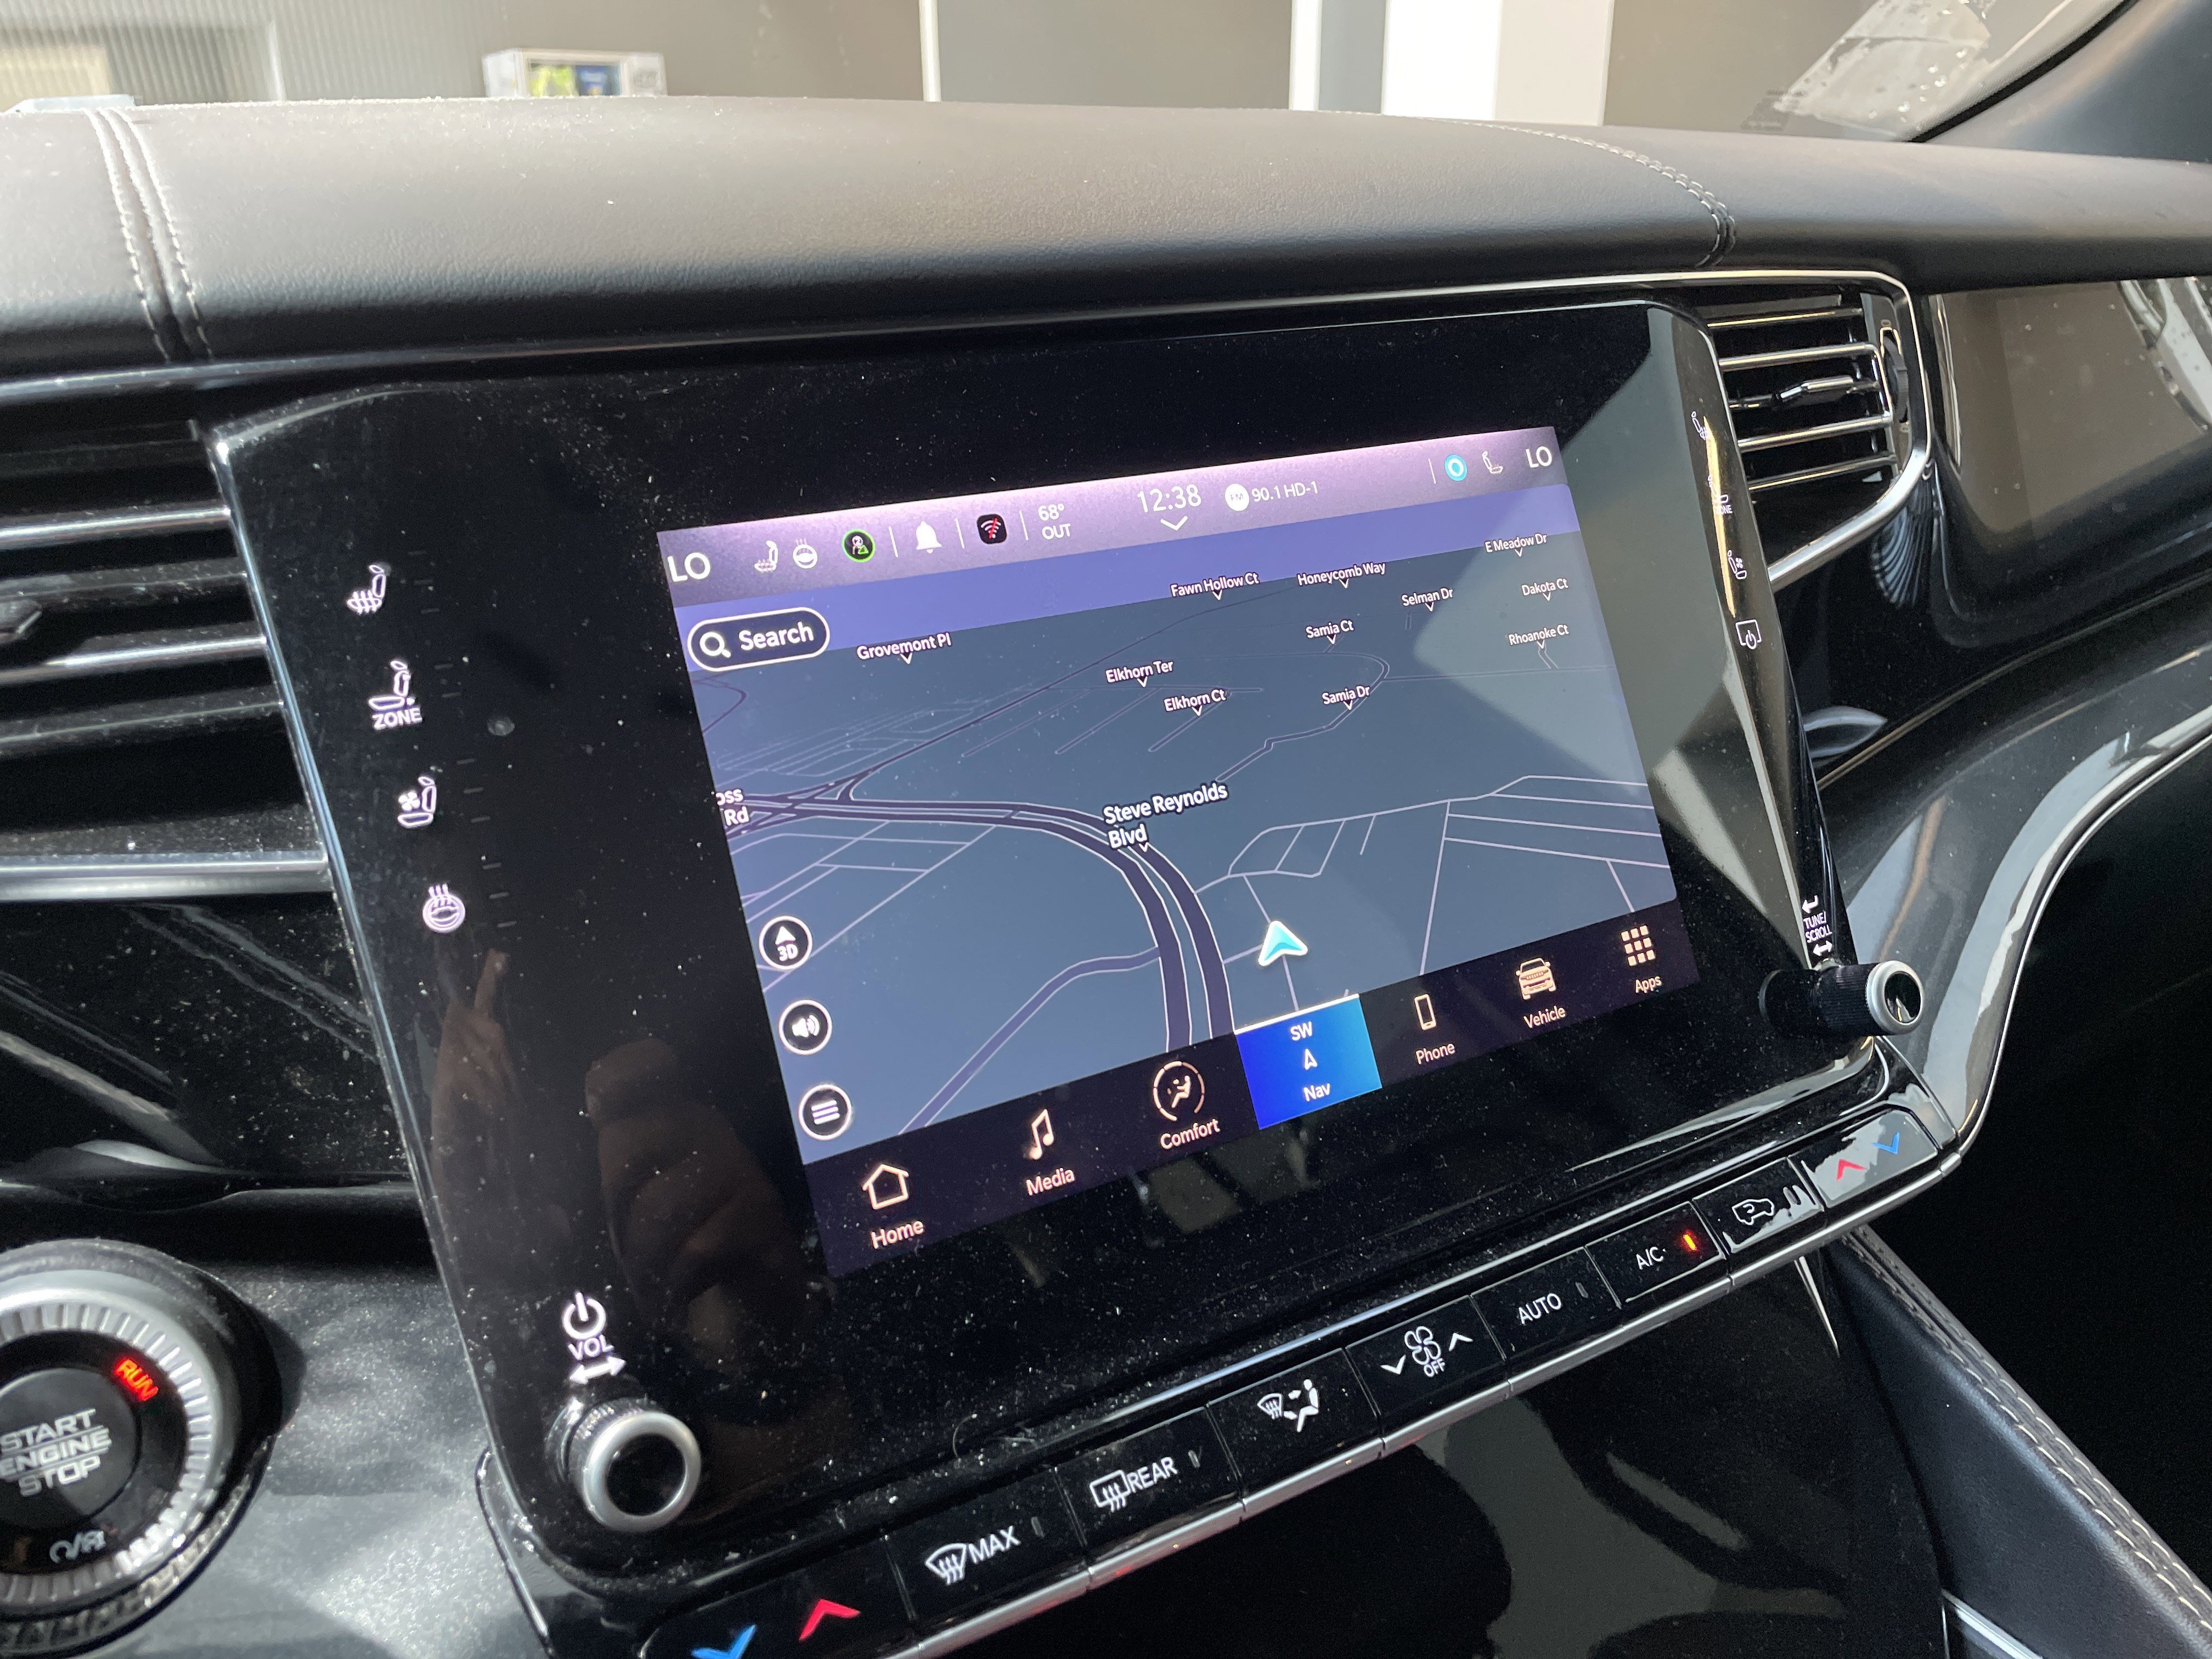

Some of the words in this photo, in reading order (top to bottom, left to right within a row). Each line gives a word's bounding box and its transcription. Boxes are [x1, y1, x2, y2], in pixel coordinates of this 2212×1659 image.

[1526, 445, 1553, 469] LO
[1137, 483, 1201, 513] 12:38
[1251, 485, 1281, 503] 90.1
[1283, 481, 1318, 498] HD-1
[1042, 524, 1071, 540] OUT
[1485, 541, 1493, 553] E
[1493, 535, 1534, 552] Meadow
[1534, 533, 1547, 544] Dr
[667, 552, 711, 583] LO
[1297, 565, 1362, 586] Honeycomb
[1363, 561, 1386, 575] Way
[1170, 584, 1202, 597] Fawn
[1204, 577, 1243, 592] Hollow
[1243, 573, 1259, 585] Ct
[1402, 590, 1439, 606] Selman
[1440, 588, 1454, 598] Dr
[1521, 579, 1556, 596] Dakota
[1556, 577, 1569, 589] Ct
[738, 621, 814, 652] Search
[1306, 622, 1339, 639] Samia
[1340, 619, 1355, 633] Ct
[1508, 627, 1556, 646] Rhoanoke
[1557, 624, 1570, 636] Ct
[856, 636, 936, 661] Grovemont
[936, 632, 952, 650] Pl
[1105, 662, 1153, 684] Elkhorn
[1153, 660, 1174, 674] Ter
[1164, 690, 1210, 712] Elkhorn
[1211, 689, 1227, 702] Ct
[1322, 687, 1356, 706] Samia
[1356, 684, 1370, 697] Dr
[372, 707, 423, 730] ZONE
[724, 805, 749, 826] Rd
[1103, 802, 1152, 825] Steve
[1152, 782, 1228, 814] Reynolds
[1108, 823, 1148, 849] Blvd
[1803, 910, 1827, 929] TUNE/
[1805, 924, 1833, 943] SCROLL
[777, 944, 799, 962] 3D
[1634, 974, 1662, 994] Apps
[1523, 1004, 1567, 1030] Vehicle
[1290, 1021, 1313, 1041] SW
[1415, 1040, 1455, 1065] Phone
[1304, 1082, 1331, 1102] Nav
[1160, 1117, 1221, 1151] Comfort
[1025, 1167, 1076, 1197] Media
[871, 1218, 925, 1249] Home
[1635, 1246, 1664, 1271] A/C
[1517, 1292, 1562, 1325] AUTO
[567, 1334, 614, 1361] VOL
[1423, 1357, 1446, 1378] OFF
[114, 1358, 159, 1402] RUN
[0, 1408, 96, 1453] START
[0, 1427, 112, 1477] ENGINE
[18, 1454, 101, 1497] STOP
[1127, 1456, 1178, 1494] REAR
[968, 1525, 1022, 1564] MAX
